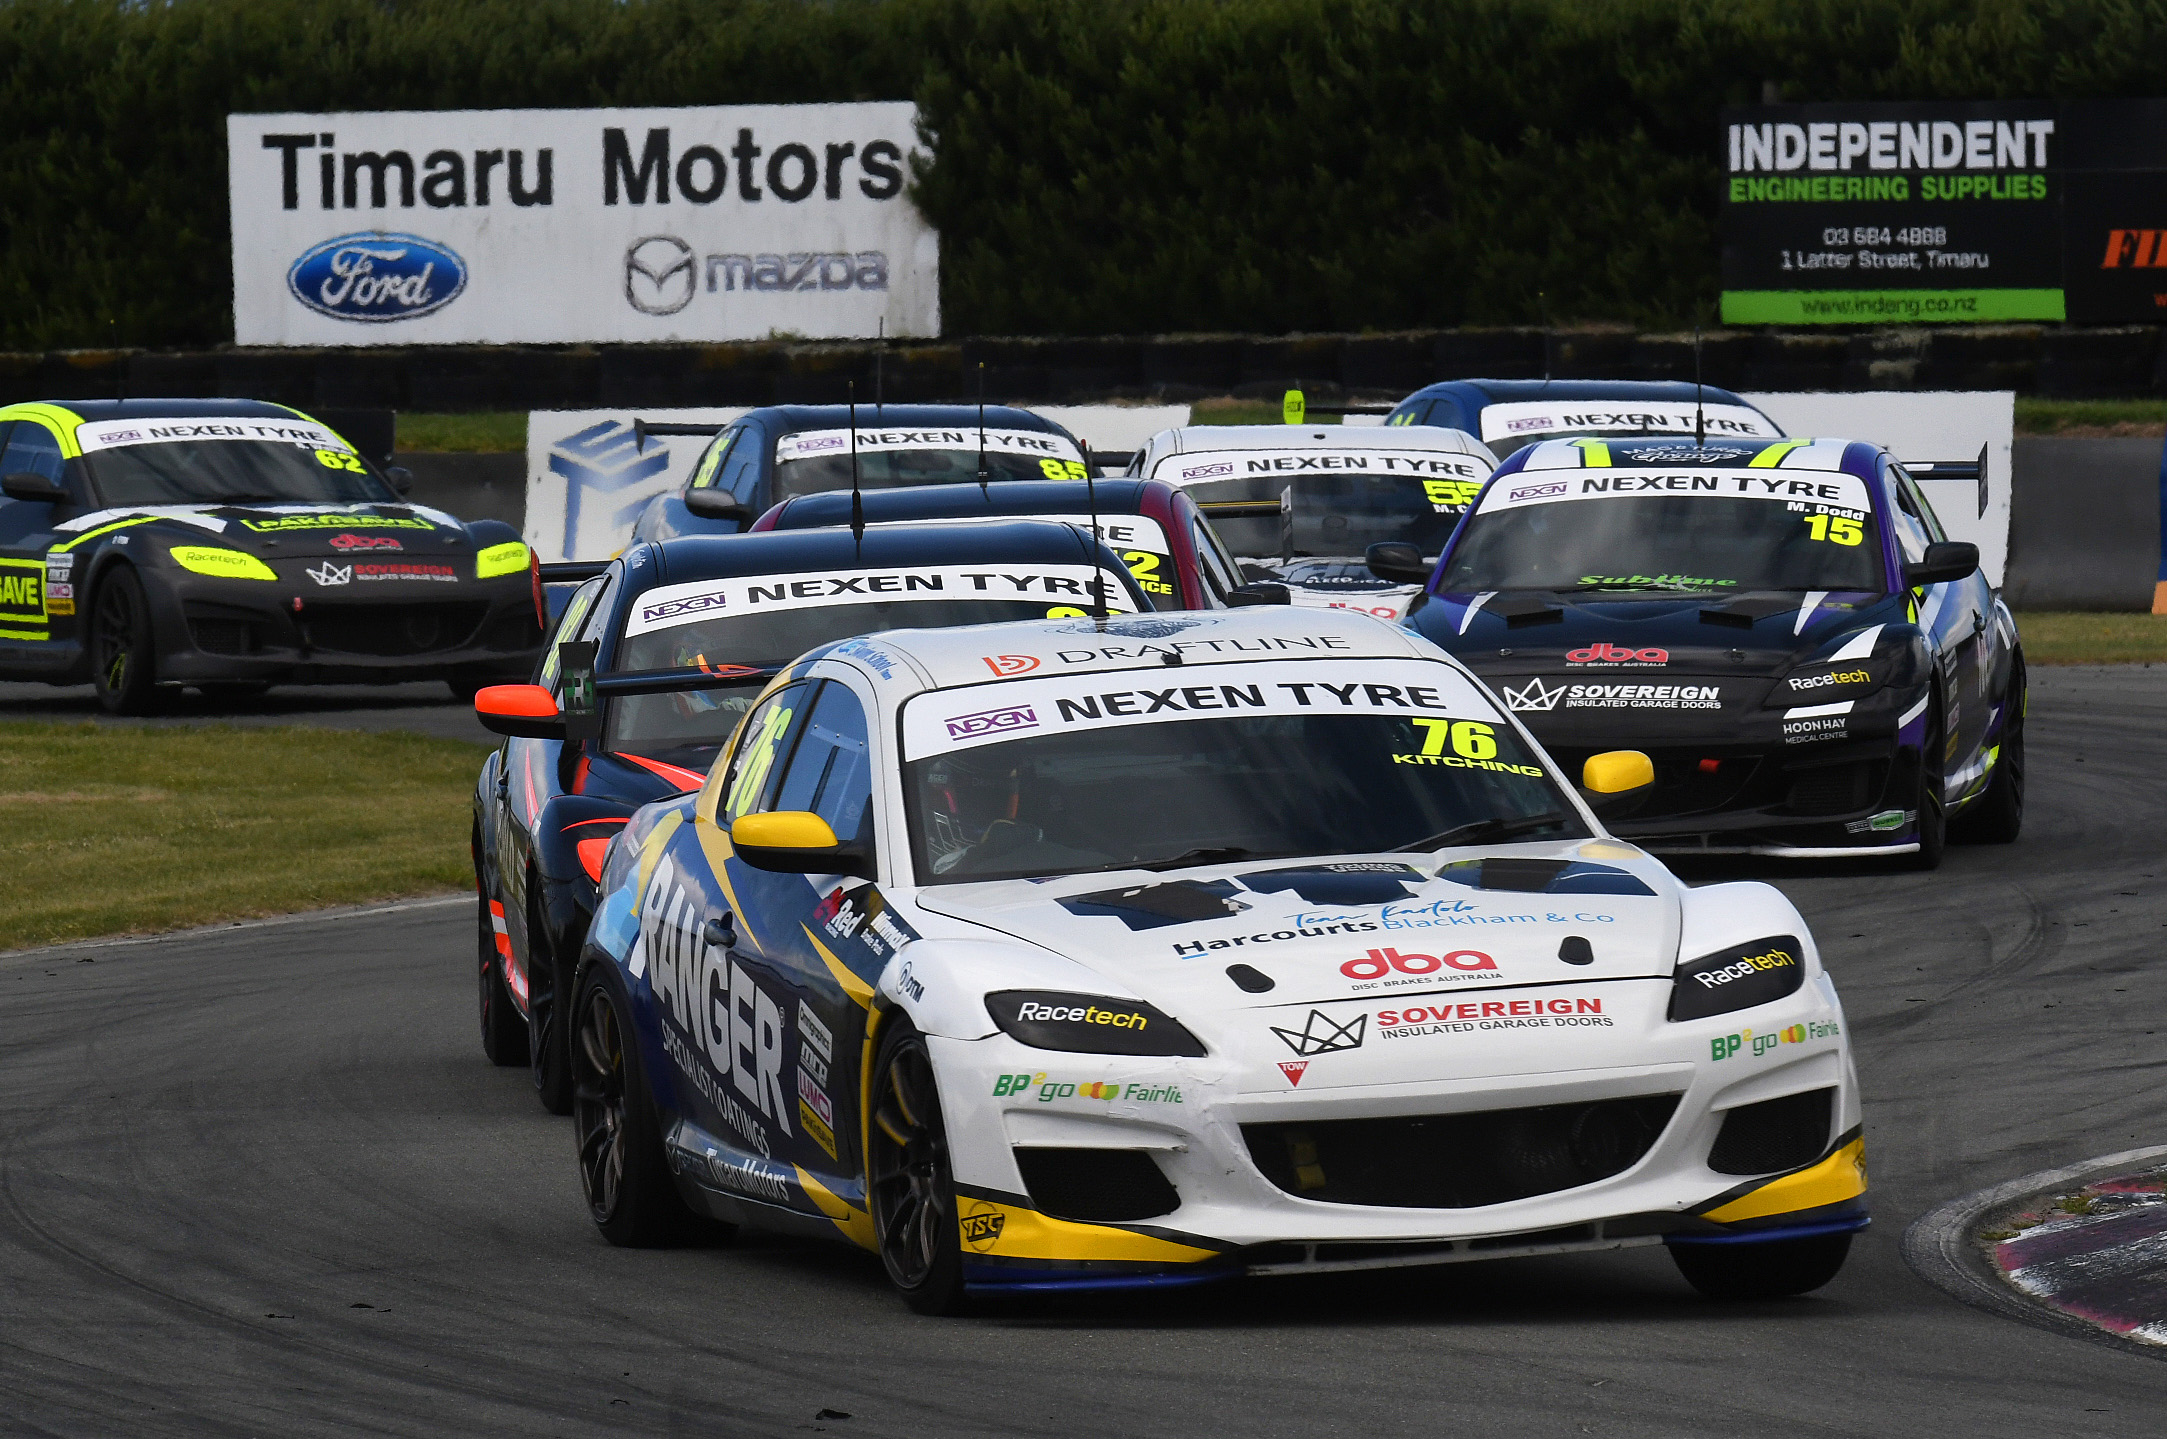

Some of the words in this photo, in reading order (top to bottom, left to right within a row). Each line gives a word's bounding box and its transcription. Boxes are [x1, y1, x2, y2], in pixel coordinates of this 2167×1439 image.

[1728, 119, 2056, 172] INDEPENDENT
[262, 132, 554, 210] Timaru
[602, 127, 903, 205] Motors
[1729, 176, 1909, 203] ENGINEERING
[1920, 174, 2048, 200] SUPPLIES
[706, 250, 889, 292] mazda
[1926, 250, 1990, 269] Timaru
[320, 247, 434, 307] Ford
[150, 425, 246, 439] NEXEN
[249, 426, 326, 443] TYRE
[1563, 412, 1668, 427] NEXEN
[1674, 414, 1760, 435] TYRE
[856, 432, 964, 447] NEXEN
[972, 433, 1061, 453] TYRE
[314, 449, 368, 476] 62
[1038, 459, 1088, 480] 85
[1182, 461, 1234, 481] NEXEN
[1247, 456, 1368, 472] NEXEN
[1378, 457, 1476, 478] TYRE
[1422, 480, 1484, 505] 55
[1509, 480, 1569, 502] NEXEN
[1581, 475, 1719, 494] NEXEN
[1731, 477, 1841, 500] TYRE
[1786, 501, 1811, 514] M.
[1815, 503, 1866, 521] Dodd
[1803, 514, 1865, 547] 15
[1113, 549, 1161, 581] 2
[0, 575, 39, 605] AVE
[747, 573, 944, 604] NEXEN
[960, 573, 1119, 600] TYRE
[1138, 580, 1173, 595] ICE
[643, 592, 726, 623] NEXEN
[1056, 636, 1351, 664] DRAFTLINE
[1565, 643, 1669, 662] dba
[1568, 685, 1720, 700] SOVEREIGN
[1788, 669, 1871, 691] Racetech
[1054, 685, 1266, 723] NEXEN
[1277, 683, 1448, 710] TYRE
[1566, 699, 1629, 708] INSULATED
[1630, 700, 1679, 709] GARAGE
[1680, 701, 1722, 709] DOORS
[943, 703, 1041, 741] NEXEN
[1783, 720, 1821, 734] HOON
[1822, 718, 1846, 730] HAY
[1412, 718, 1498, 760] 76
[1785, 734, 1819, 744] MEDICAL
[1819, 731, 1848, 740] CENTRE
[1392, 754, 1544, 777] KITCHING
[830, 898, 866, 939] Red
[1172, 919, 1378, 956] Harcourts
[1385, 912, 1538, 930] Blackham
[1545, 911, 1569, 922] &
[1575, 911, 1615, 923] Co
[1339, 947, 1499, 981] dba
[1693, 948, 1796, 989] Racetech
[1351, 982, 1378, 991] DISC
[1383, 977, 1432, 988] BRAKES
[1437, 972, 1504, 983] AUSTRALIA
[629, 852, 793, 1139] RANGER
[1017, 1002, 1148, 1031] Racetech
[1377, 998, 1602, 1027] SOVEREIGN
[1380, 1024, 1475, 1040] INSULATED
[1479, 1018, 1552, 1031] GARAGE
[1554, 1016, 1615, 1028] DOORS
[1280, 1062, 1306, 1071] TOW
[661, 1018, 712, 1099] SPECIALIST
[710, 1080, 771, 1160] COATINGS
[1124, 1083, 1184, 1104] Fairlie
